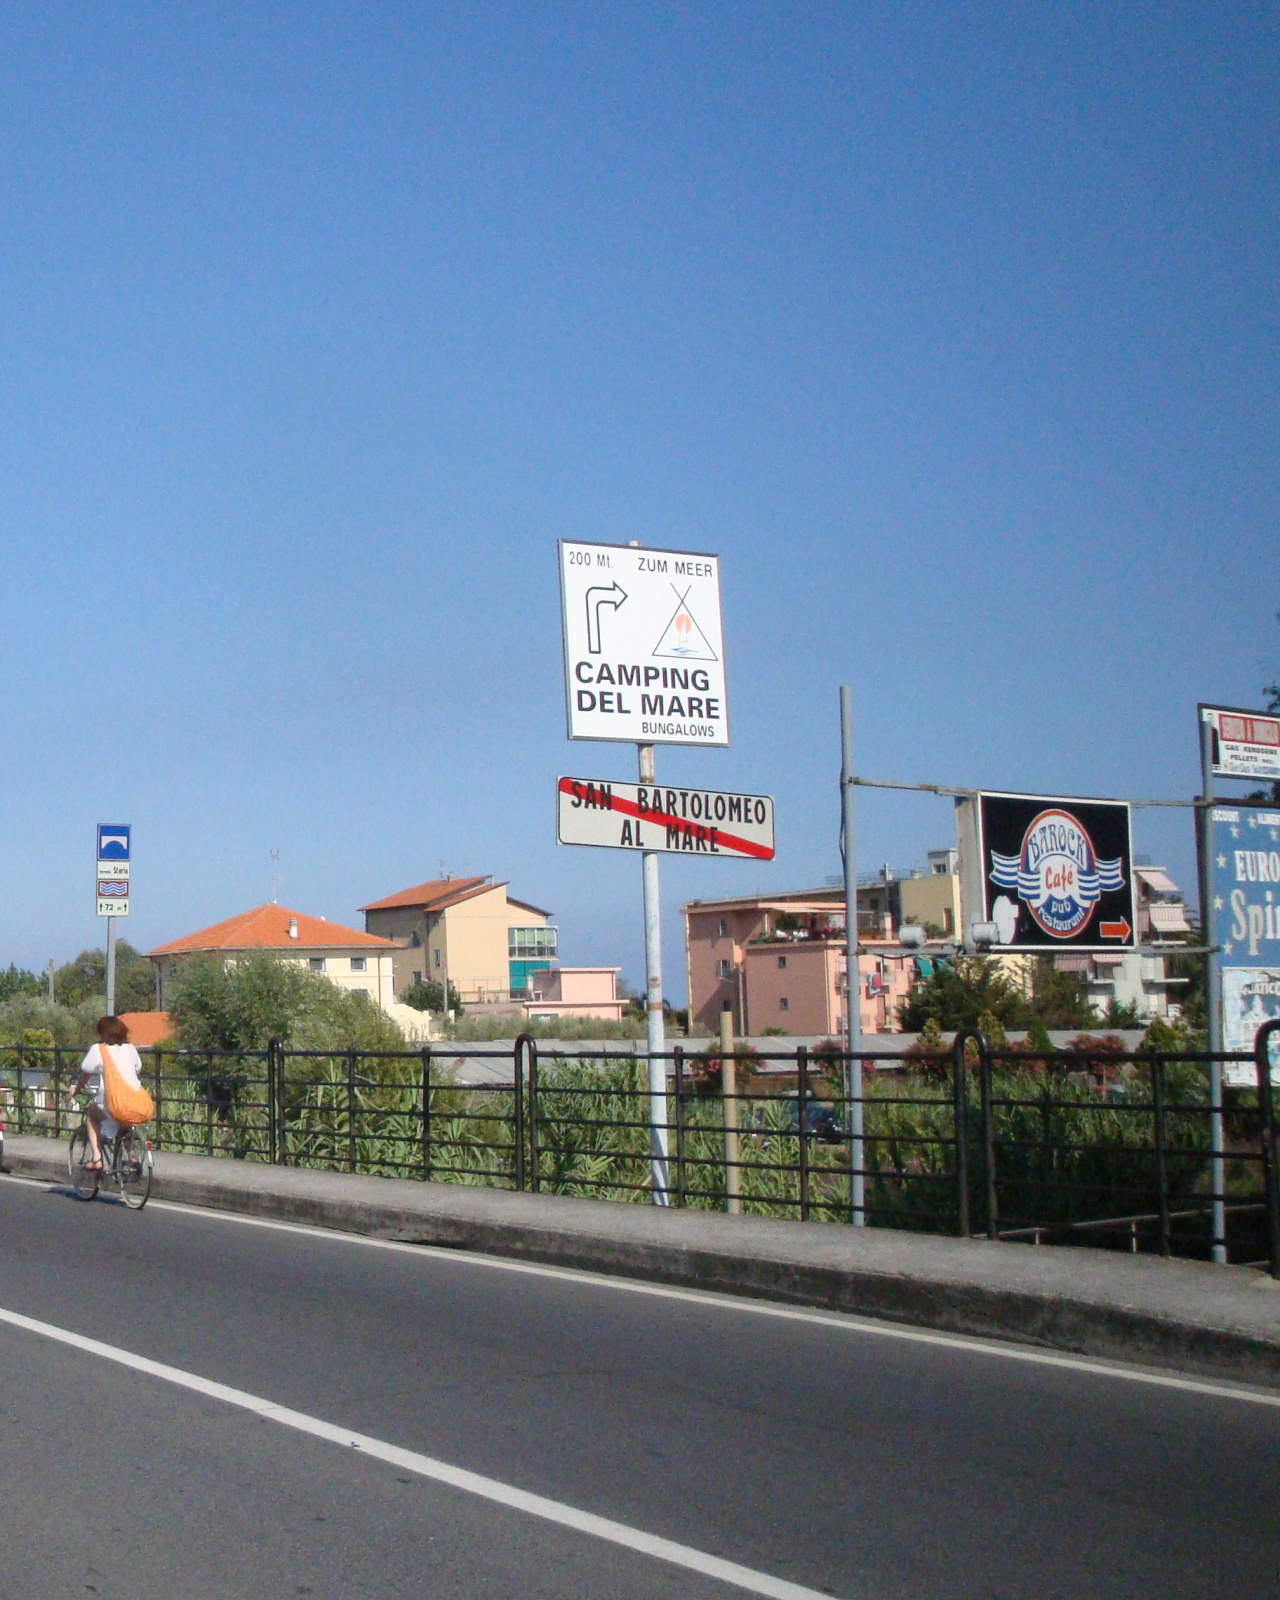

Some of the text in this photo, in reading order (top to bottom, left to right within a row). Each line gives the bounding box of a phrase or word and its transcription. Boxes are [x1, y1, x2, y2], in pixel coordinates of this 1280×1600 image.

[569, 551, 591, 566] 200
[638, 557, 713, 577] ZUM MEER
[575, 661, 709, 691] CAMPING
[577, 690, 720, 720] DEL MARE
[642, 721, 715, 738] BUNGALOWS
[570, 781, 766, 825] SAN BARTOLOMEO
[621, 819, 720, 853] AL MARE
[1028, 824, 1085, 866] BAROCK
[1045, 863, 1073, 892] Café
[1234, 850, 1280, 882] EURO
[105, 903, 114, 911] 72
[1037, 906, 1085, 931] restaurant
[1051, 900, 1071, 914] pub
